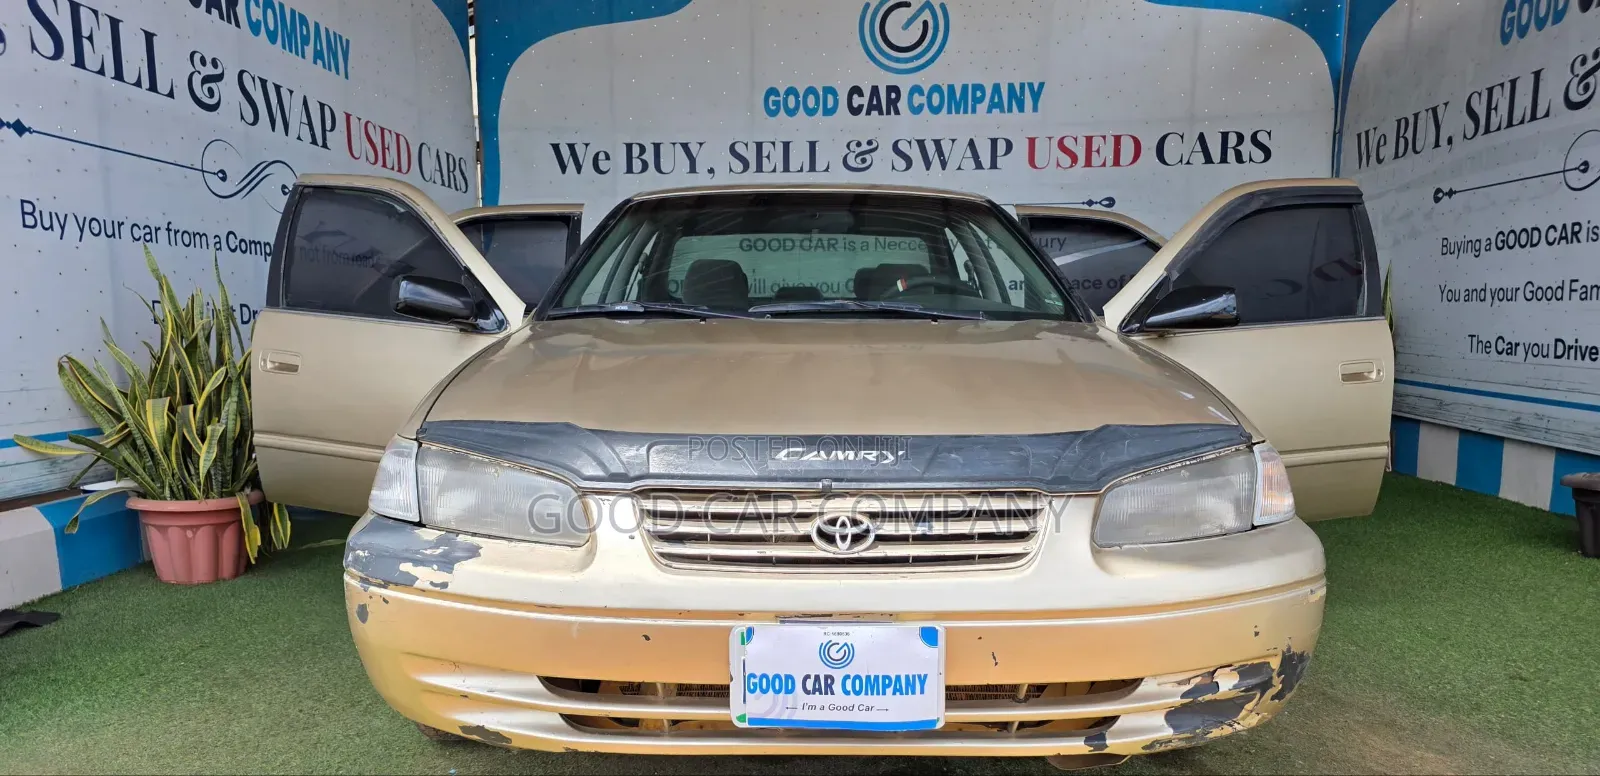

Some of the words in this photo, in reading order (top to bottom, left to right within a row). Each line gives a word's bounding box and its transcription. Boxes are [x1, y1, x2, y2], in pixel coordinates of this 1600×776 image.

[245, 0, 350, 80] COMPANY
[27, 0, 175, 100] SELL
[187, 50, 225, 112] &
[237, 69, 337, 150] SWAP
[343, 111, 412, 175] USED
[417, 142, 469, 194] CARS
[763, 86, 839, 118] GOOD
[846, 84, 901, 116] CAR
[907, 81, 1045, 115] COMPANY
[1356, 126, 1387, 169] We
[1392, 101, 1453, 152] BUY,
[1463, 68, 1551, 142] SELL
[1563, 47, 1600, 111] &
[549, 142, 611, 175] We
[623, 141, 716, 179] BUY,
[728, 140, 830, 174] SELL
[842, 139, 879, 173] &
[891, 136, 1014, 172] SWAP
[1025, 134, 1142, 170] USED
[1155, 129, 1272, 166] CARS
[20, 199, 68, 241] Buy
[73, 212, 125, 243] your
[130, 222, 161, 244] car
[165, 221, 209, 250] from
[213, 234, 222, 252] a
[226, 230, 273, 262] Comp
[738, 237, 796, 252] GOOD
[800, 237, 838, 251] CAR
[843, 236, 856, 251] is
[863, 240, 869, 251] a
[1441, 234, 1481, 258] Buying
[1484, 237, 1492, 252] a
[1495, 226, 1541, 251] GOOD
[1545, 221, 1582, 246] CAR
[1586, 220, 1599, 243] is
[1439, 283, 1461, 303] You
[1463, 283, 1487, 303] and
[1490, 285, 1520, 307] your
[1523, 280, 1565, 302] Good
[1569, 279, 1600, 301] Fam
[1468, 334, 1492, 354] The
[1495, 335, 1520, 356] Car
[1523, 341, 1550, 362] you
[1553, 338, 1599, 362] Drive
[775, 447, 905, 464] CAMRY
[746, 672, 796, 695] GOOD
[801, 673, 835, 696] CAR
[841, 673, 929, 697] COMPANY
[828, 702, 855, 712] Good
[857, 703, 875, 712] Car
